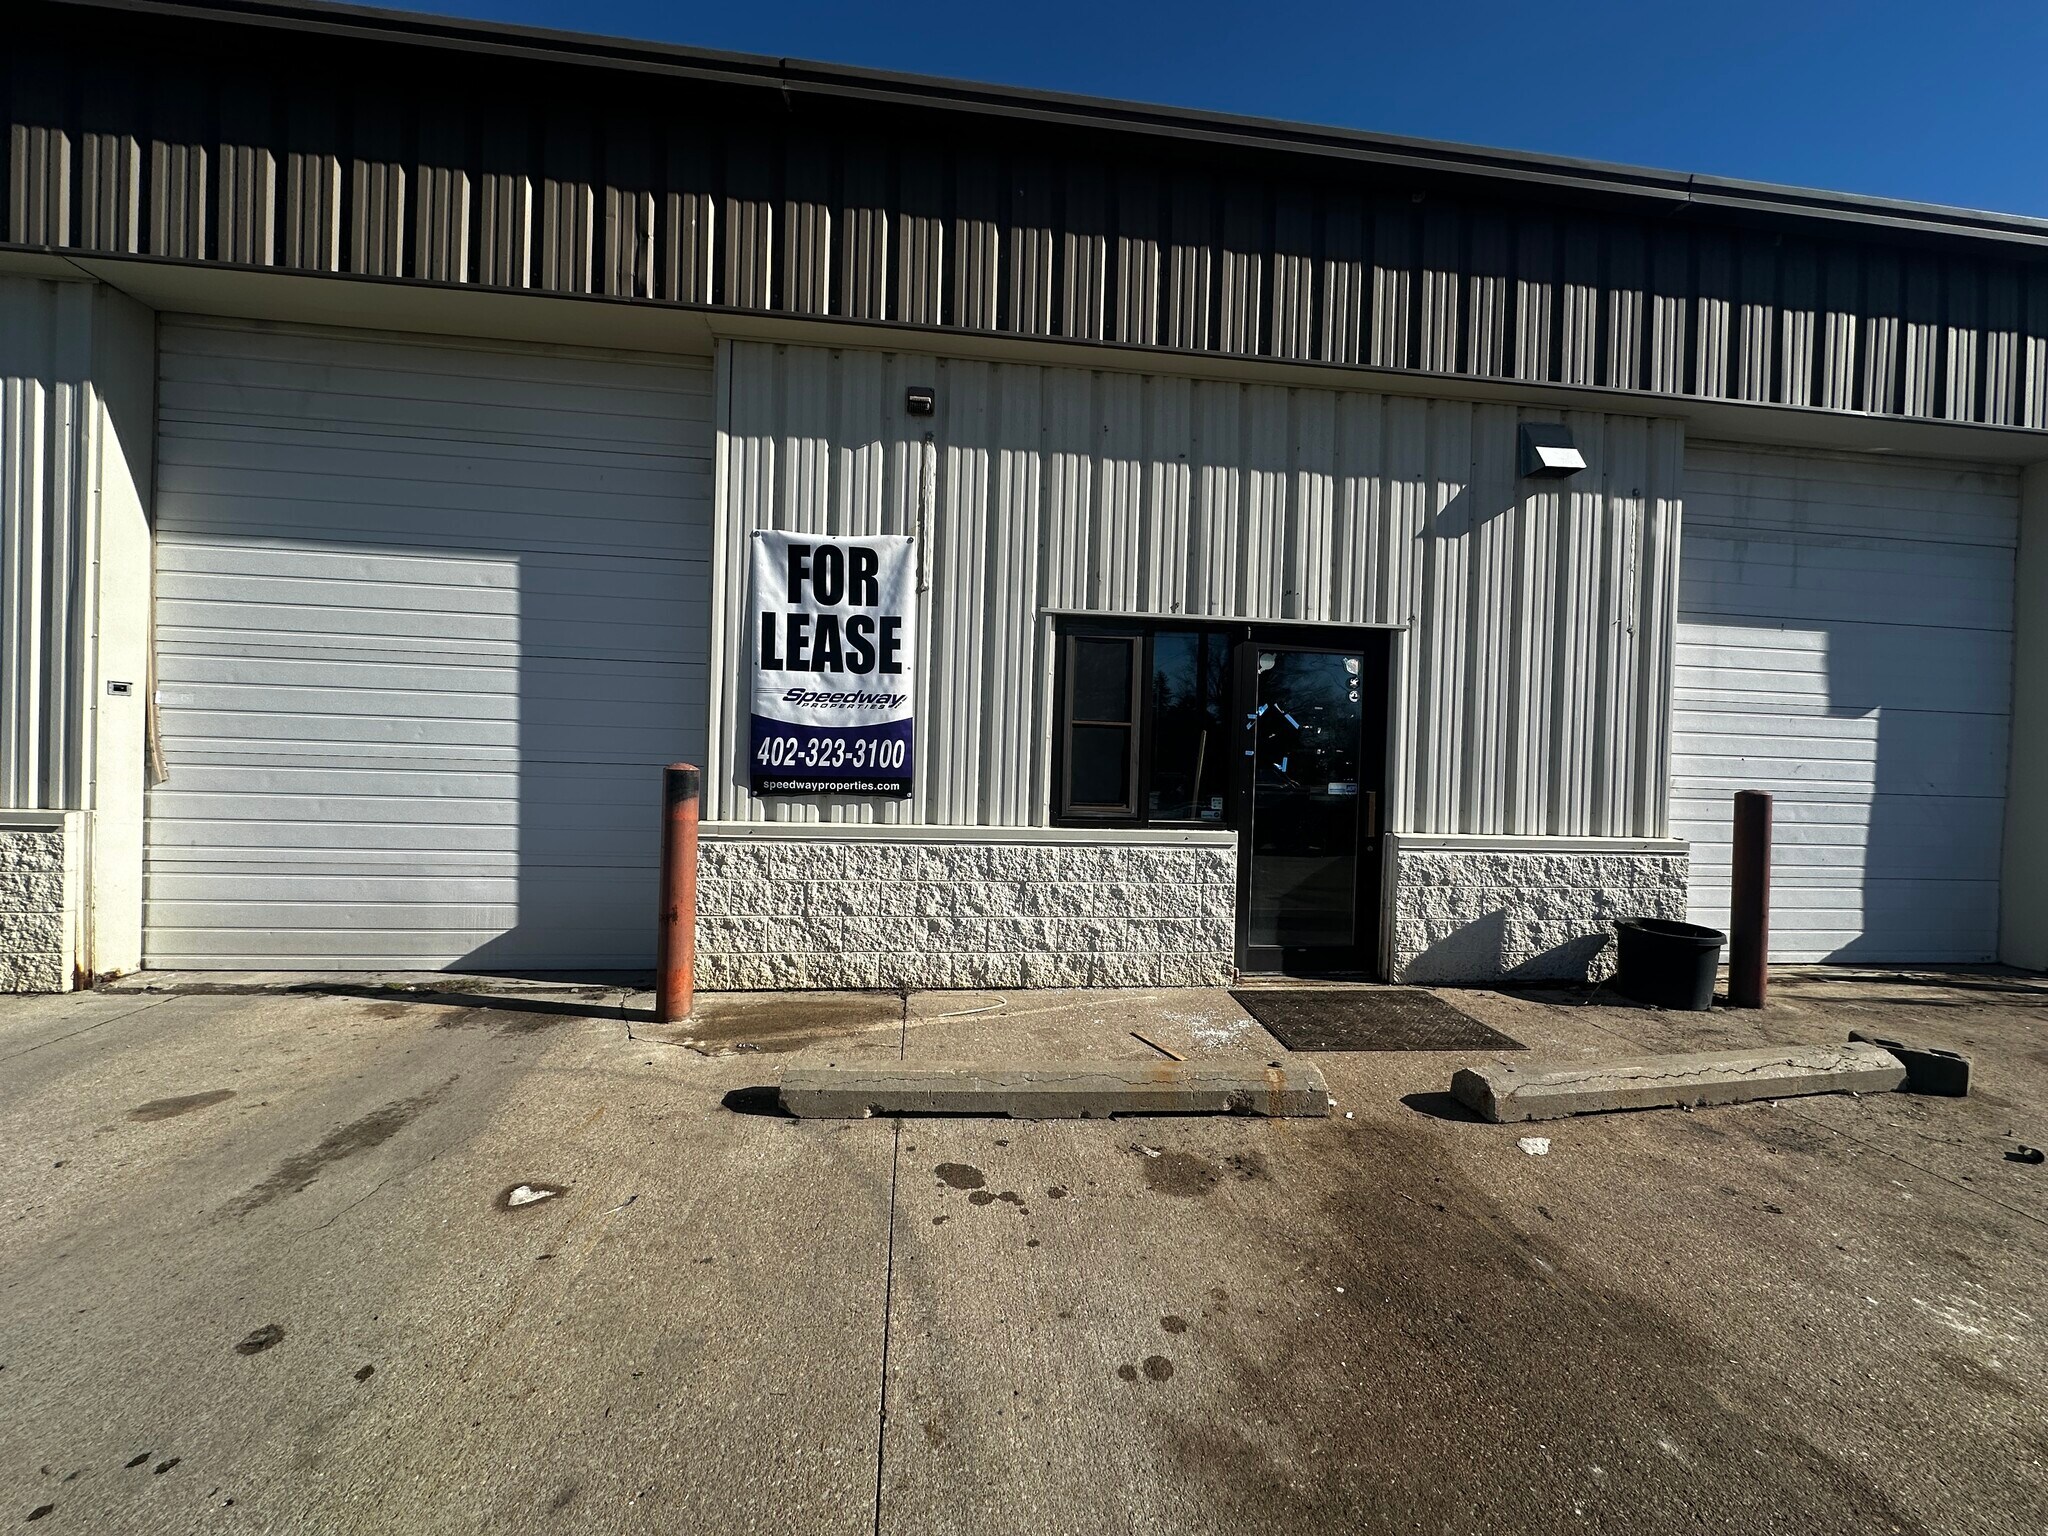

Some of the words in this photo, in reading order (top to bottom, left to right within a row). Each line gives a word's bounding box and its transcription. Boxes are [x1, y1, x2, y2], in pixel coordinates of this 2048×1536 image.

[787, 544, 879, 607] FOR
[760, 611, 903, 675] LEASE
[782, 688, 905, 708] Speedway
[757, 736, 906, 769] 402-323-3100
[763, 780, 900, 792] speedwayproperties.com
